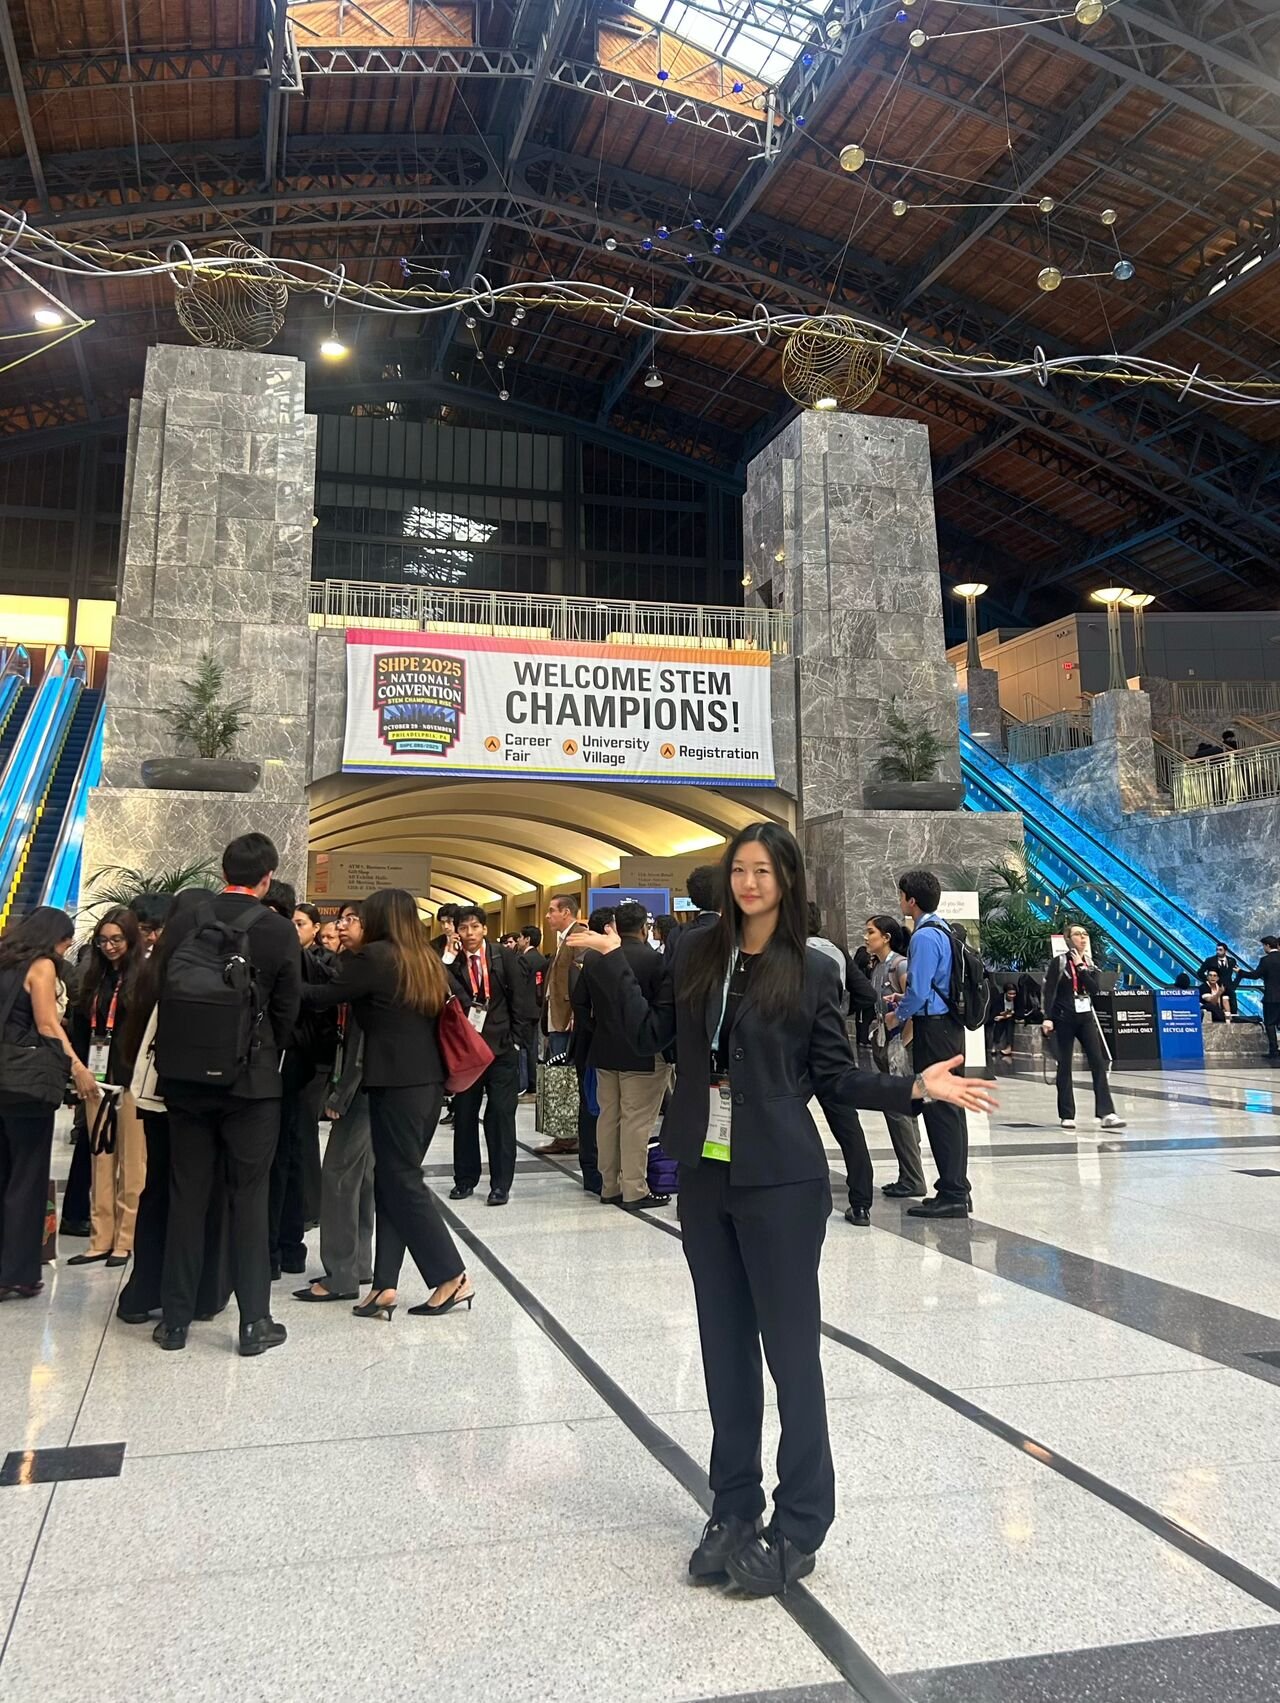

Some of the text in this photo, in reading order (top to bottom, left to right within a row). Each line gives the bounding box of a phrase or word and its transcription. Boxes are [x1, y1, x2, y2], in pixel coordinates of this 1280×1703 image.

[378, 657, 462, 677] SHPE 2025
[391, 673, 450, 686] NATIONAL
[514, 661, 731, 696] WELCOME STEM
[378, 684, 462, 703] CONVENTION
[404, 697, 438, 706] CHAMPIONS
[506, 690, 740, 732] CHAMPIONS!
[422, 724, 452, 733] NOVEMBER
[505, 734, 552, 748] Career
[582, 735, 650, 752] University
[505, 750, 531, 762] Fair
[583, 751, 626, 766] Village
[679, 745, 759, 760] Registration
